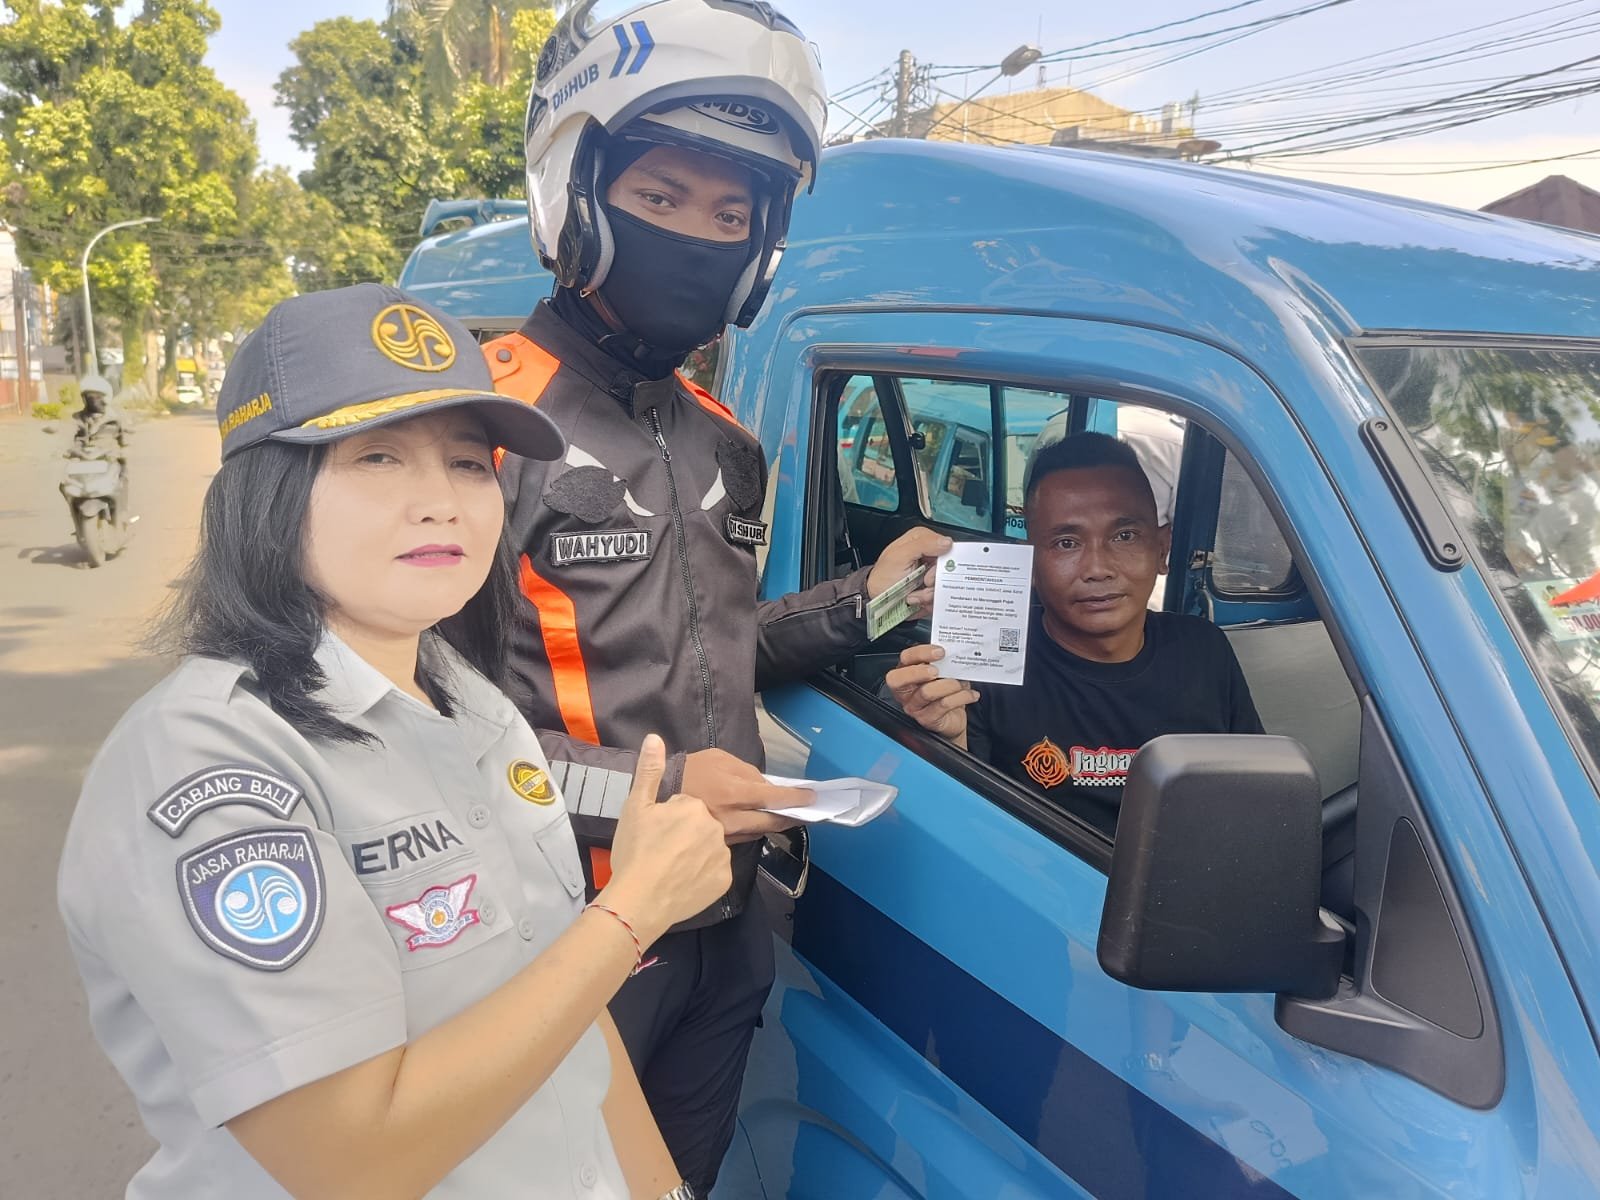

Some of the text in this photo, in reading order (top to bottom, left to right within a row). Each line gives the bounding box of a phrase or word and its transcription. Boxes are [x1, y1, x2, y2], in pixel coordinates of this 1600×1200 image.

[552, 63, 600, 112] DISHUB
[703, 101, 766, 125] MDS
[558, 533, 645, 559] WAHYUDI
[730, 520, 762, 540] DISHUB
[1072, 750, 1135, 775] Jagoa
[167, 776, 288, 819] CABANG BALI
[191, 842, 305, 885] JASA RAHARJA
[351, 819, 464, 875] ERNA
